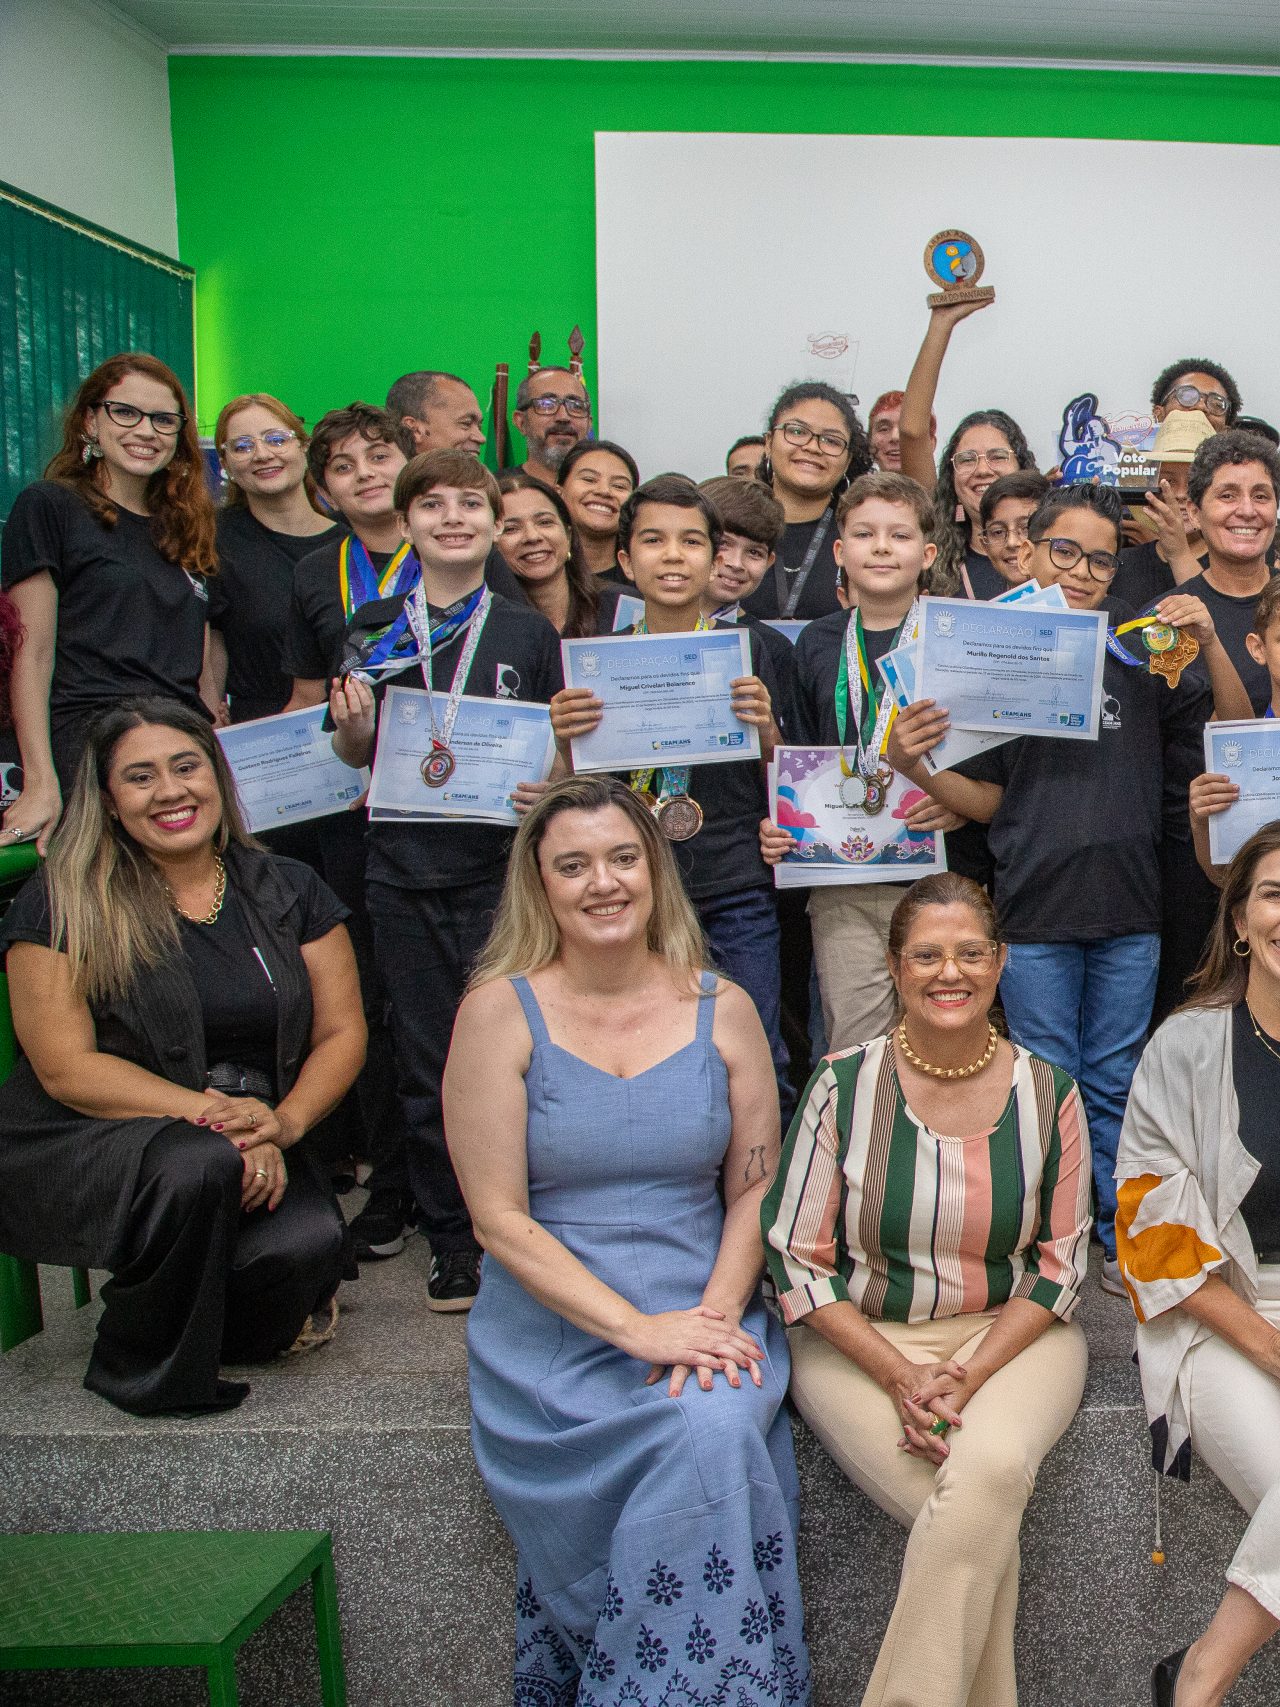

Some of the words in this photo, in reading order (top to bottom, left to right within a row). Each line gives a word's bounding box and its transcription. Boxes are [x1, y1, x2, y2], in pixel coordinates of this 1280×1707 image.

[1113, 451, 1146, 463] Voto
[1103, 464, 1157, 477] Popular
[961, 623, 1033, 638] DECLARAÇÃO
[962, 640, 992, 648] Declaramos
[607, 655, 678, 669] DECLARAÇÃO
[1030, 654, 1050, 662] Santos
